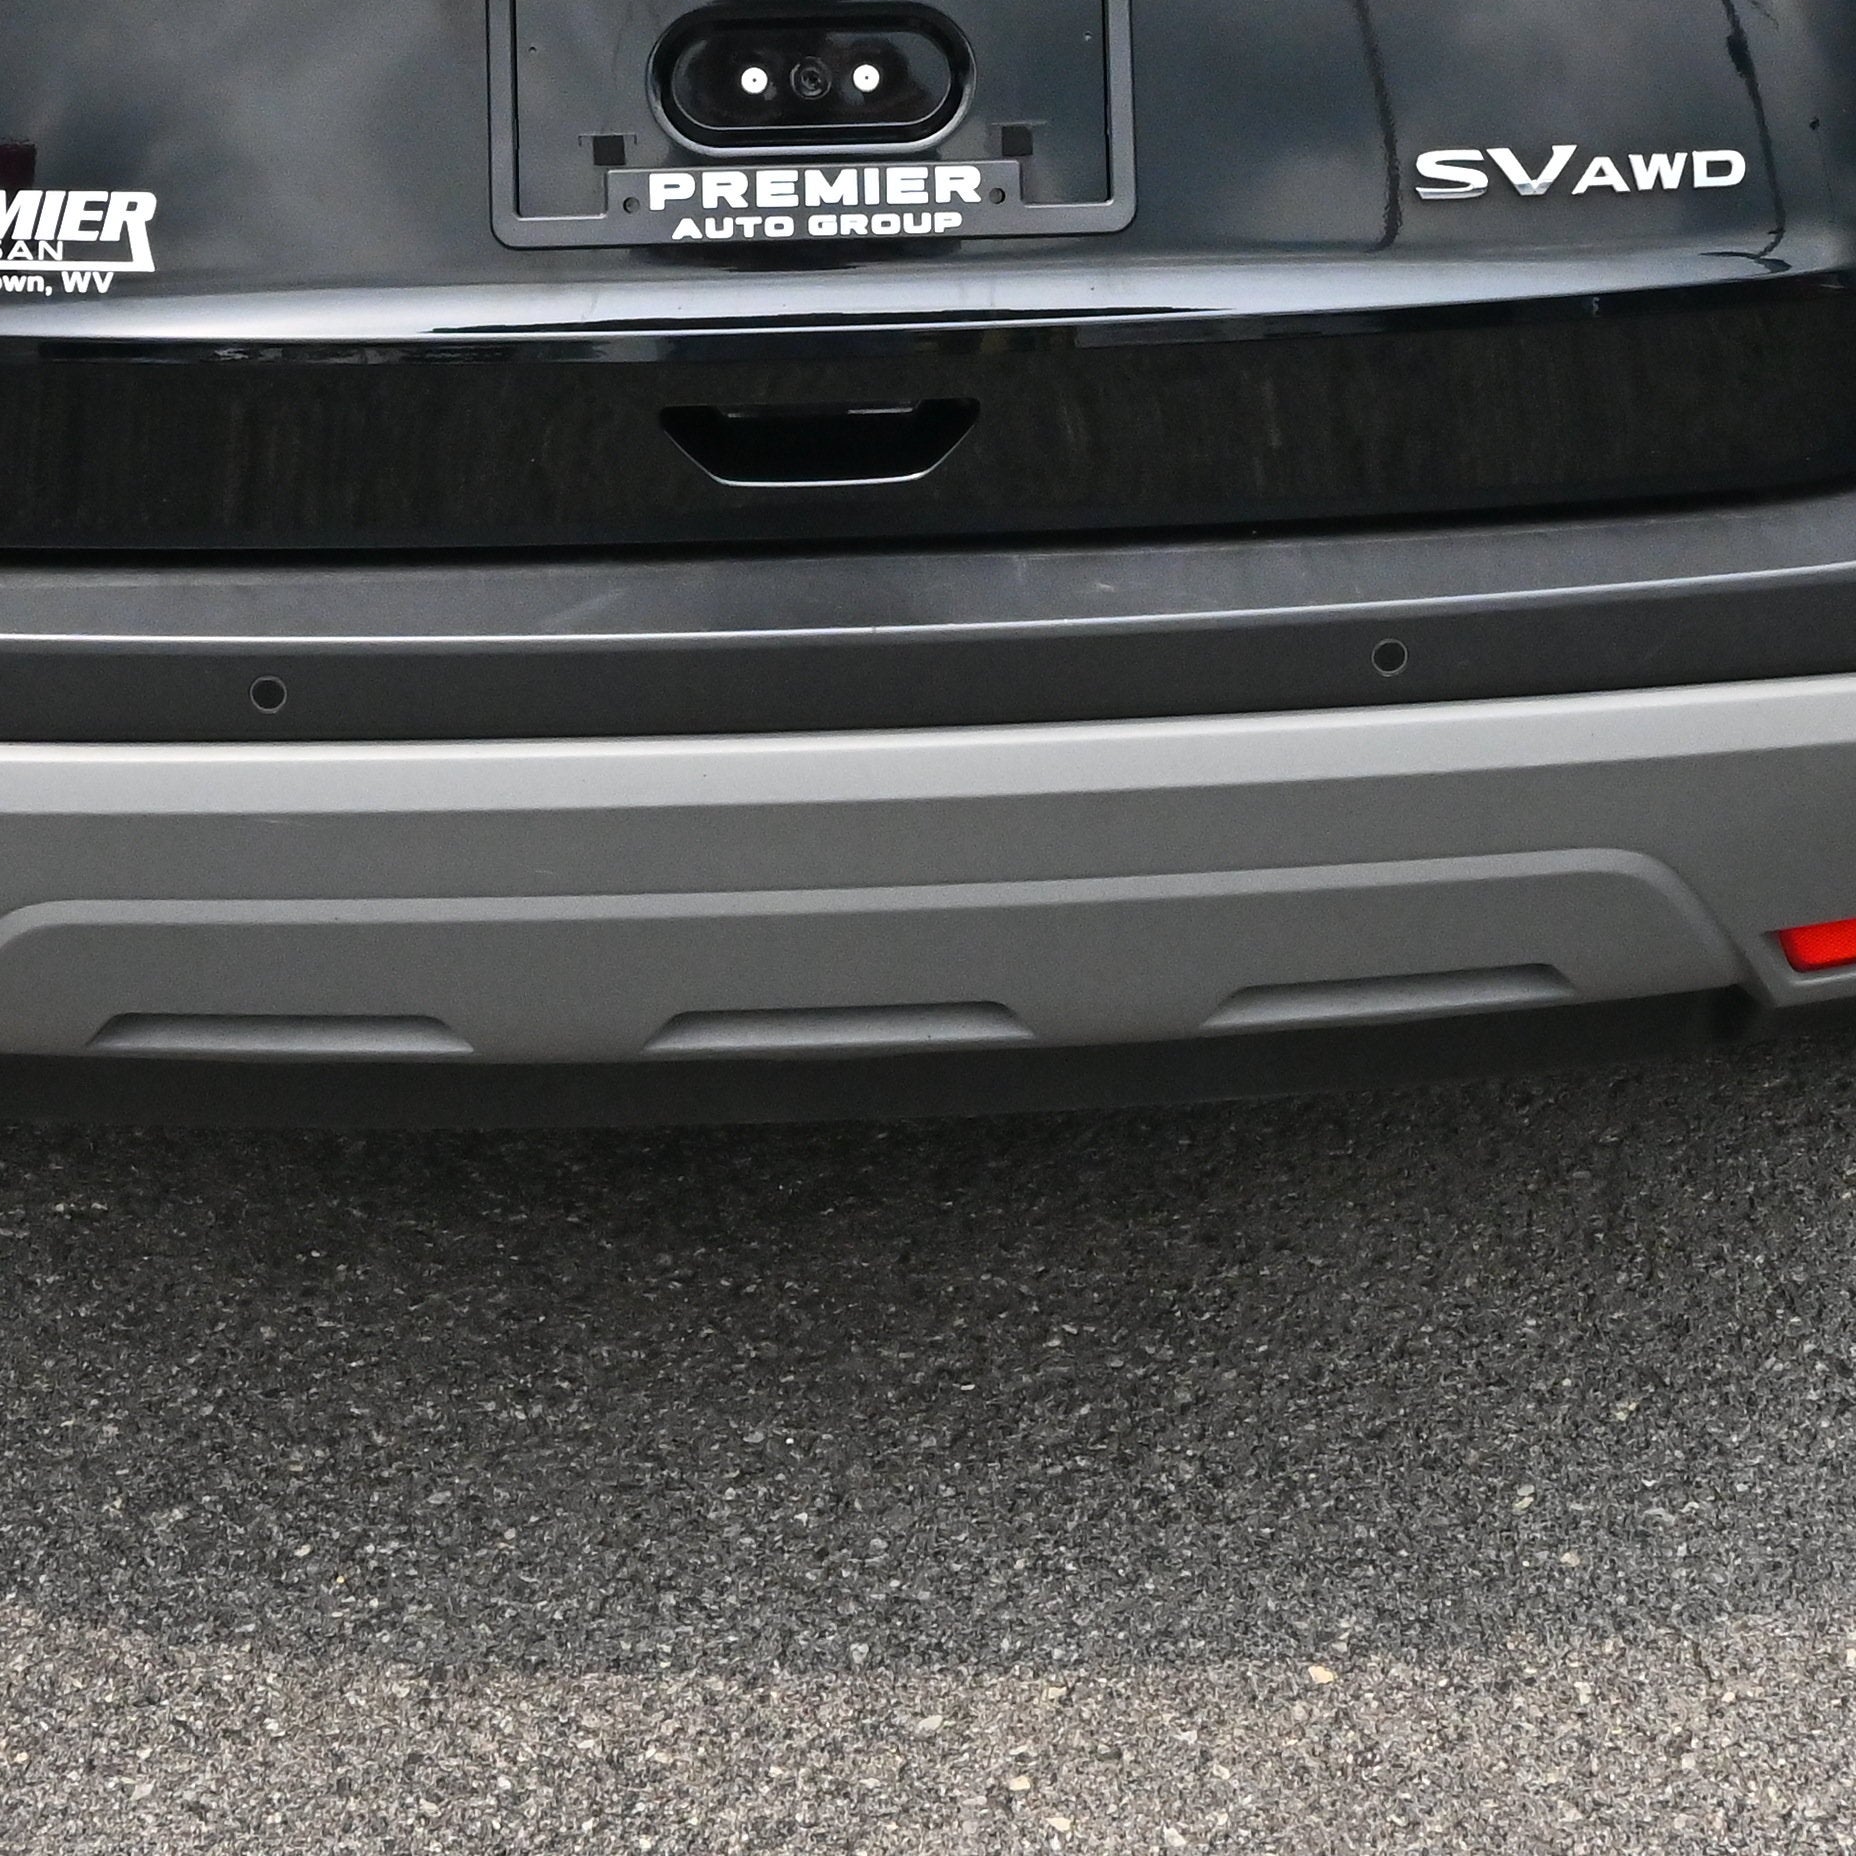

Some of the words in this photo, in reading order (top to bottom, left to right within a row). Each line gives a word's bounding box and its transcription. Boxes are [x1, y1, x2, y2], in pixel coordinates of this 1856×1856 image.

[648, 164, 983, 212] PREMIER
[671, 215, 796, 240] AUTO
[806, 210, 964, 237] GROUP
[61, 270, 115, 295] WV
